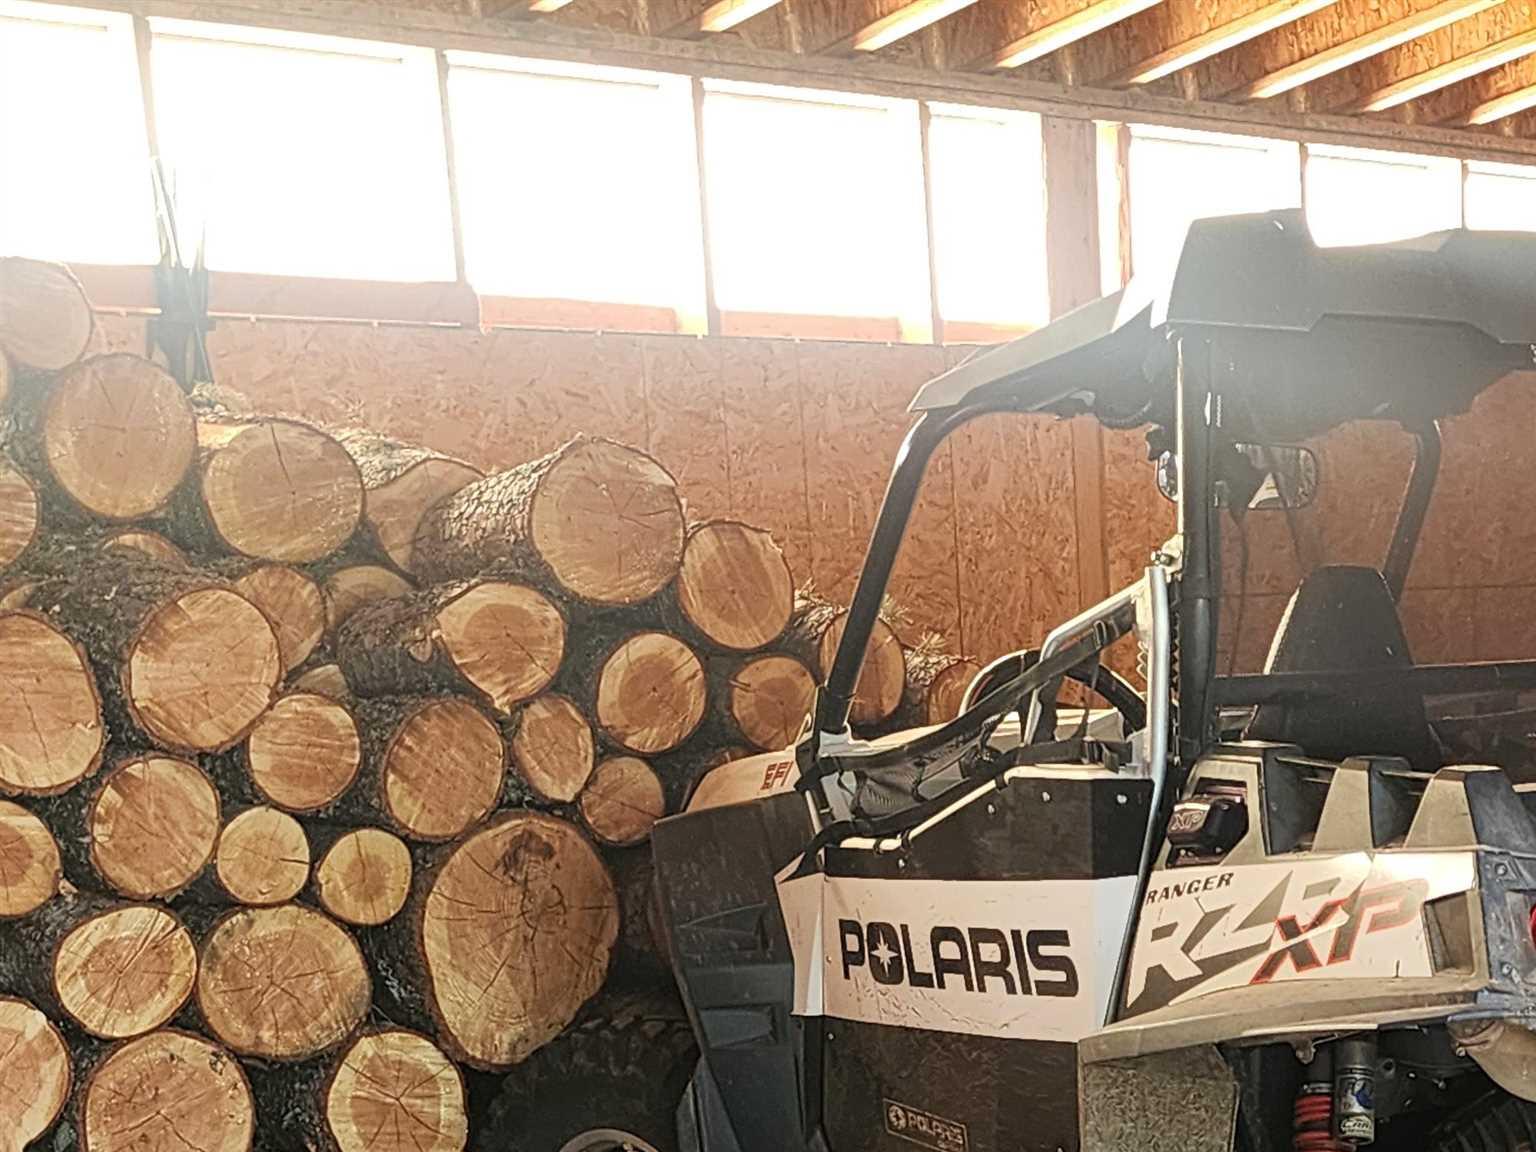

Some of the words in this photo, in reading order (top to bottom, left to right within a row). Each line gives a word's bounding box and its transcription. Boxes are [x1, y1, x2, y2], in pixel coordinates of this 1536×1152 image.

[1145, 871, 1235, 905] RANGER
[838, 918, 1079, 998] POLARIS
[1250, 878, 1430, 985] XP
[906, 1111, 964, 1145] POLARIS
